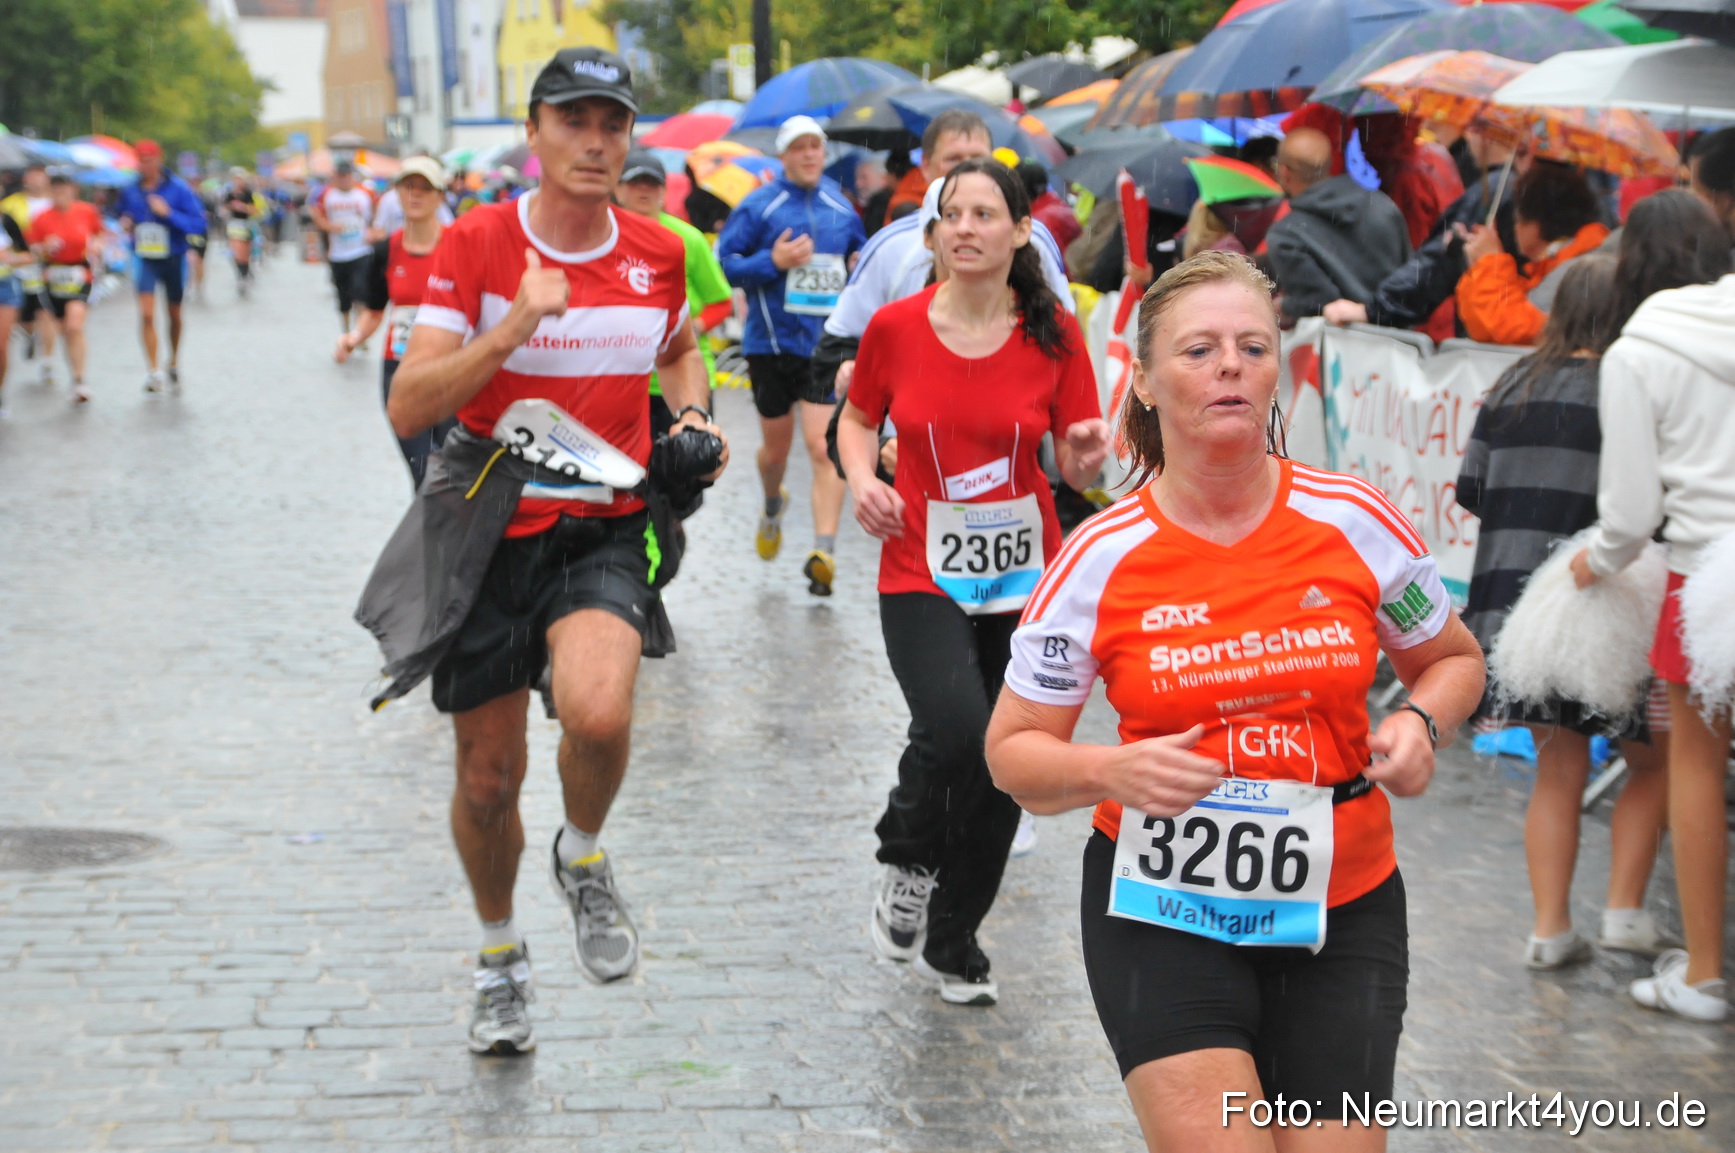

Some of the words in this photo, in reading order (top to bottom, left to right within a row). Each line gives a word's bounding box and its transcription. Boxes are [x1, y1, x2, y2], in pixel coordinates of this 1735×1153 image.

[525, 332, 652, 350] steinmarathon
[941, 528, 1032, 573] 2365
[1043, 636, 1069, 663] BR
[1150, 620, 1355, 673] SportScheck
[1178, 664, 1260, 689] Nürnberger
[1263, 652, 1328, 676] Stadtlauf
[1331, 652, 1360, 668] 2008
[1239, 725, 1308, 758] GfK
[1207, 779, 1269, 800] OCK
[1138, 816, 1310, 893] 3266
[1157, 895, 1276, 935] Waltraud
